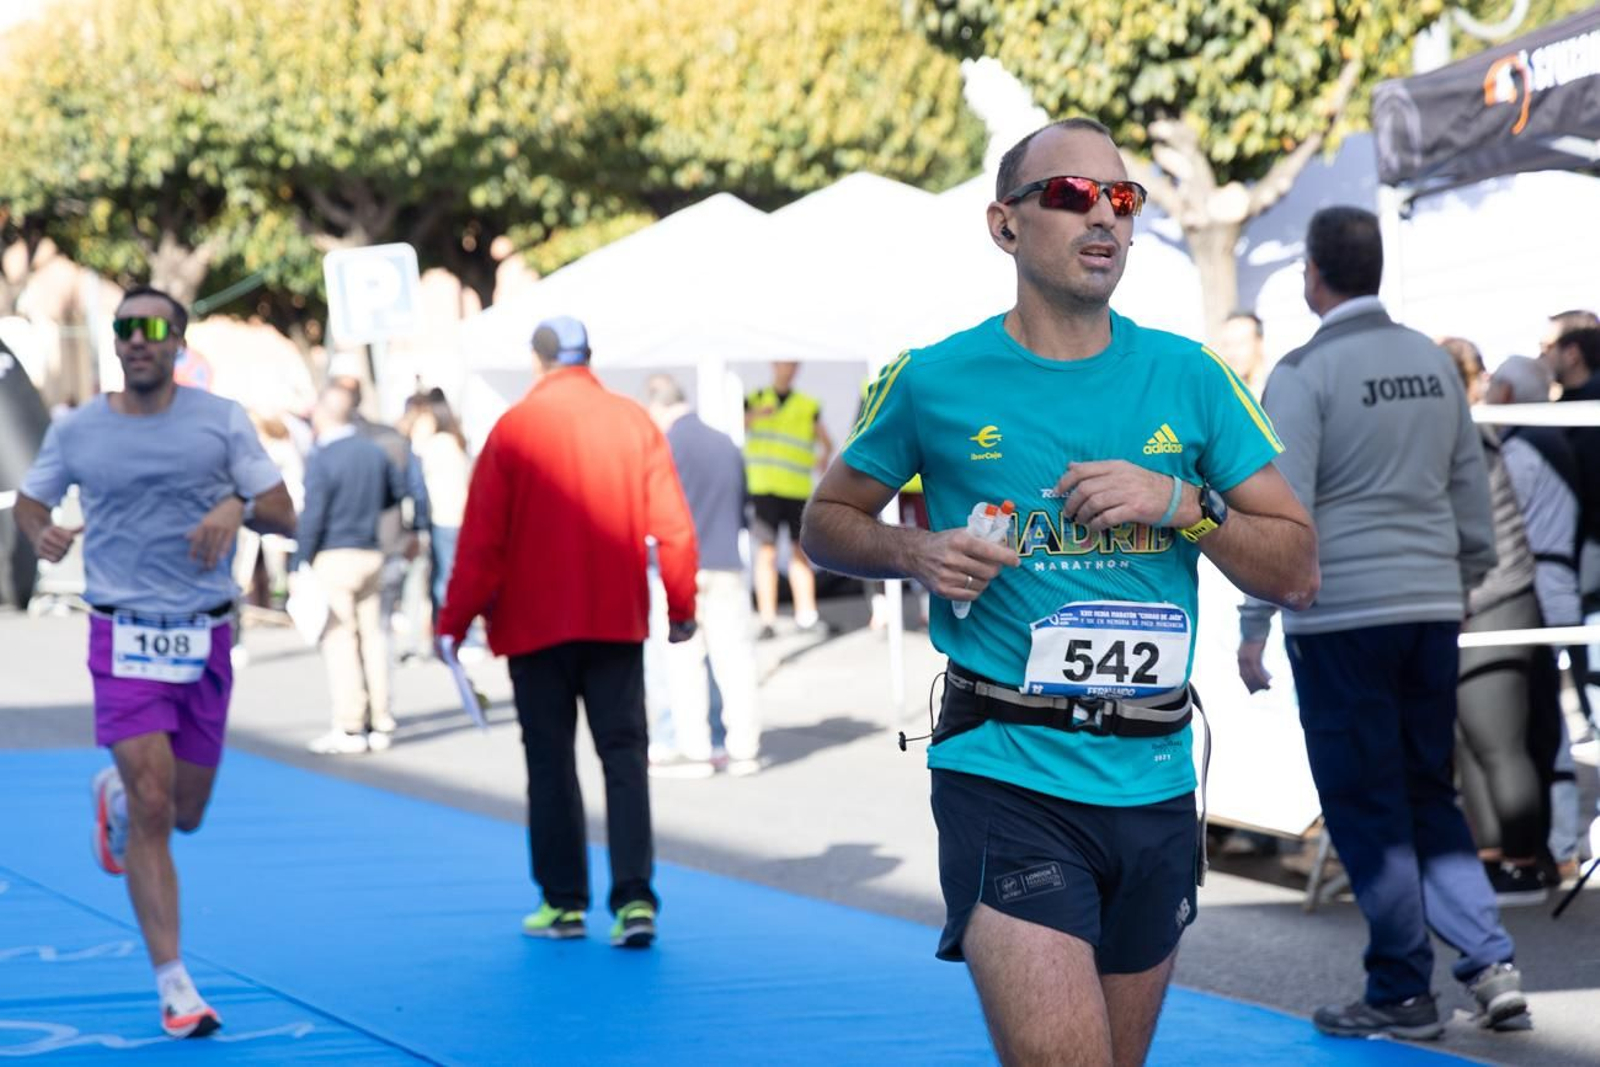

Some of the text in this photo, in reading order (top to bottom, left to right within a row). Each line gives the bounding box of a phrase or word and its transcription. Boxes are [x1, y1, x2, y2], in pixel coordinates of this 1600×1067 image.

[1143, 443, 1183, 455] adidas
[1034, 559, 1131, 572] MARATHON
[134, 632, 190, 656] 108
[1062, 639, 1159, 685] 542
